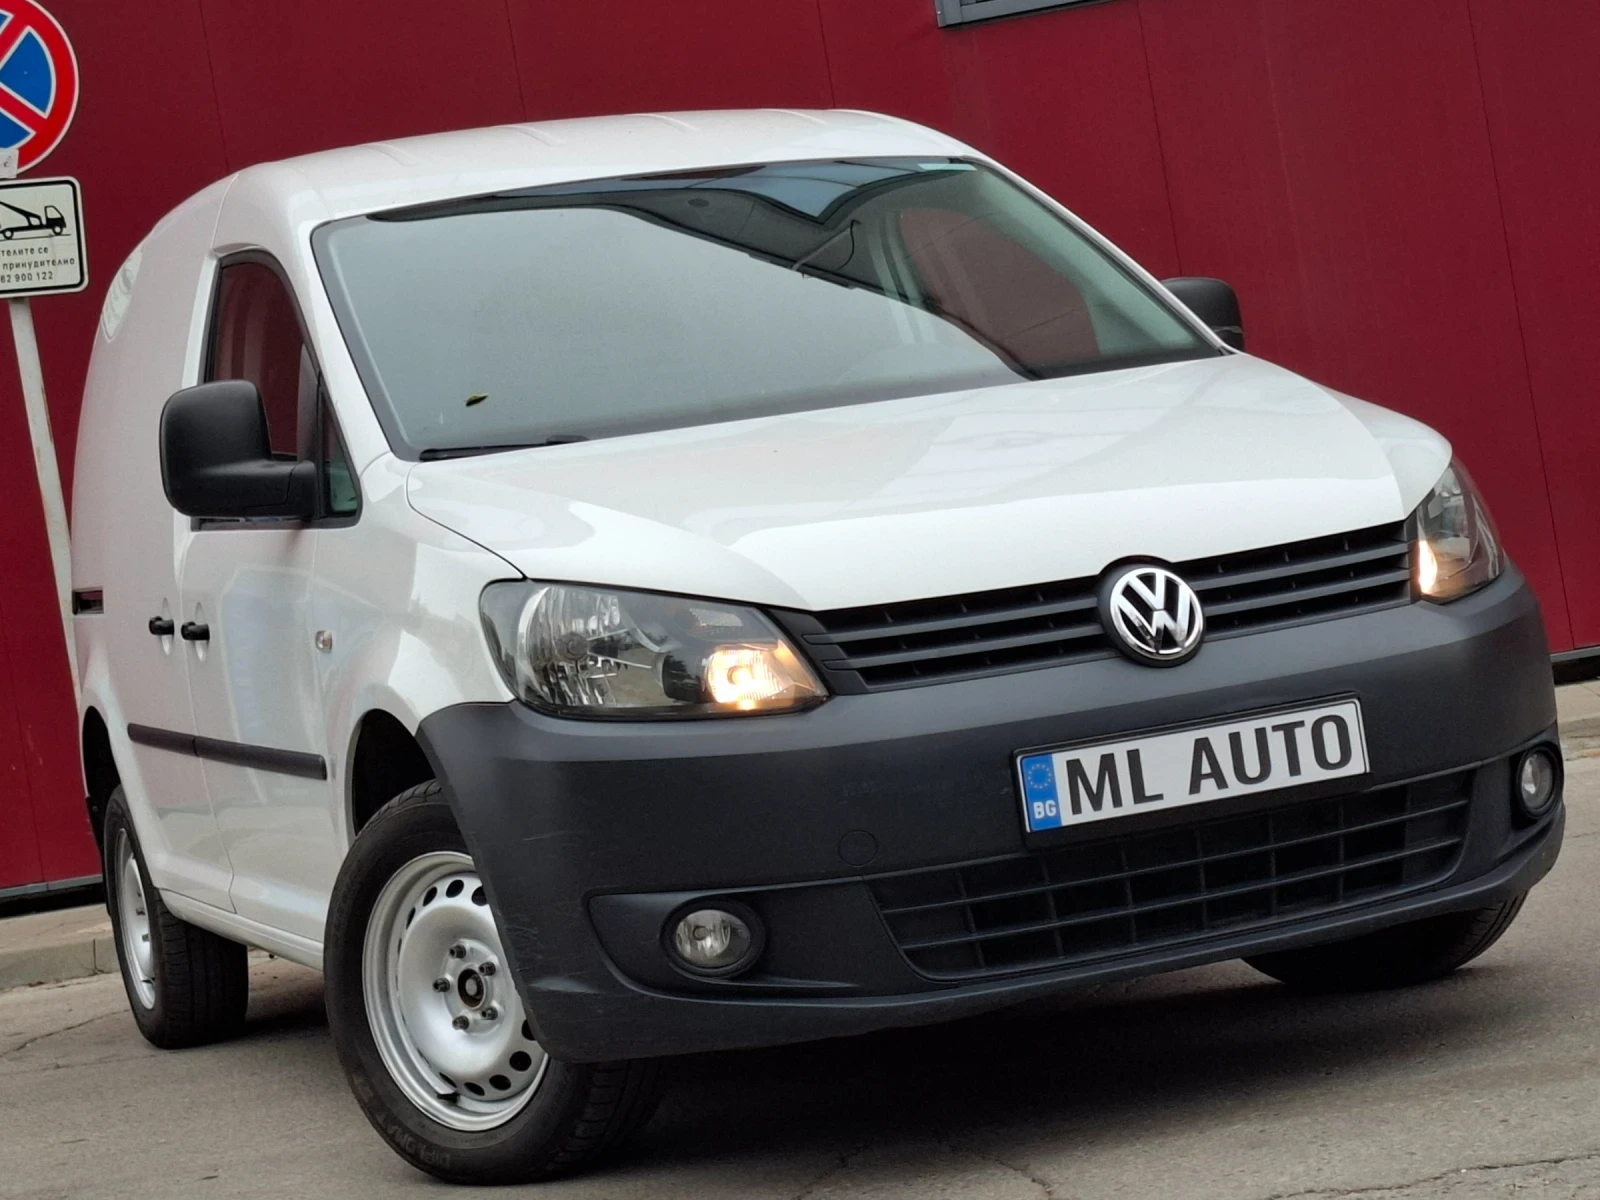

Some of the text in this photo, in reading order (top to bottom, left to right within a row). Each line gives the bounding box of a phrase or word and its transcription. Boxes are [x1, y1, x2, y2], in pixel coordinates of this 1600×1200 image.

[15, 273, 33, 283] 900
[36, 271, 53, 280] 122
[1066, 714, 1352, 815] ML AUTO
[1033, 800, 1057, 819] BG
